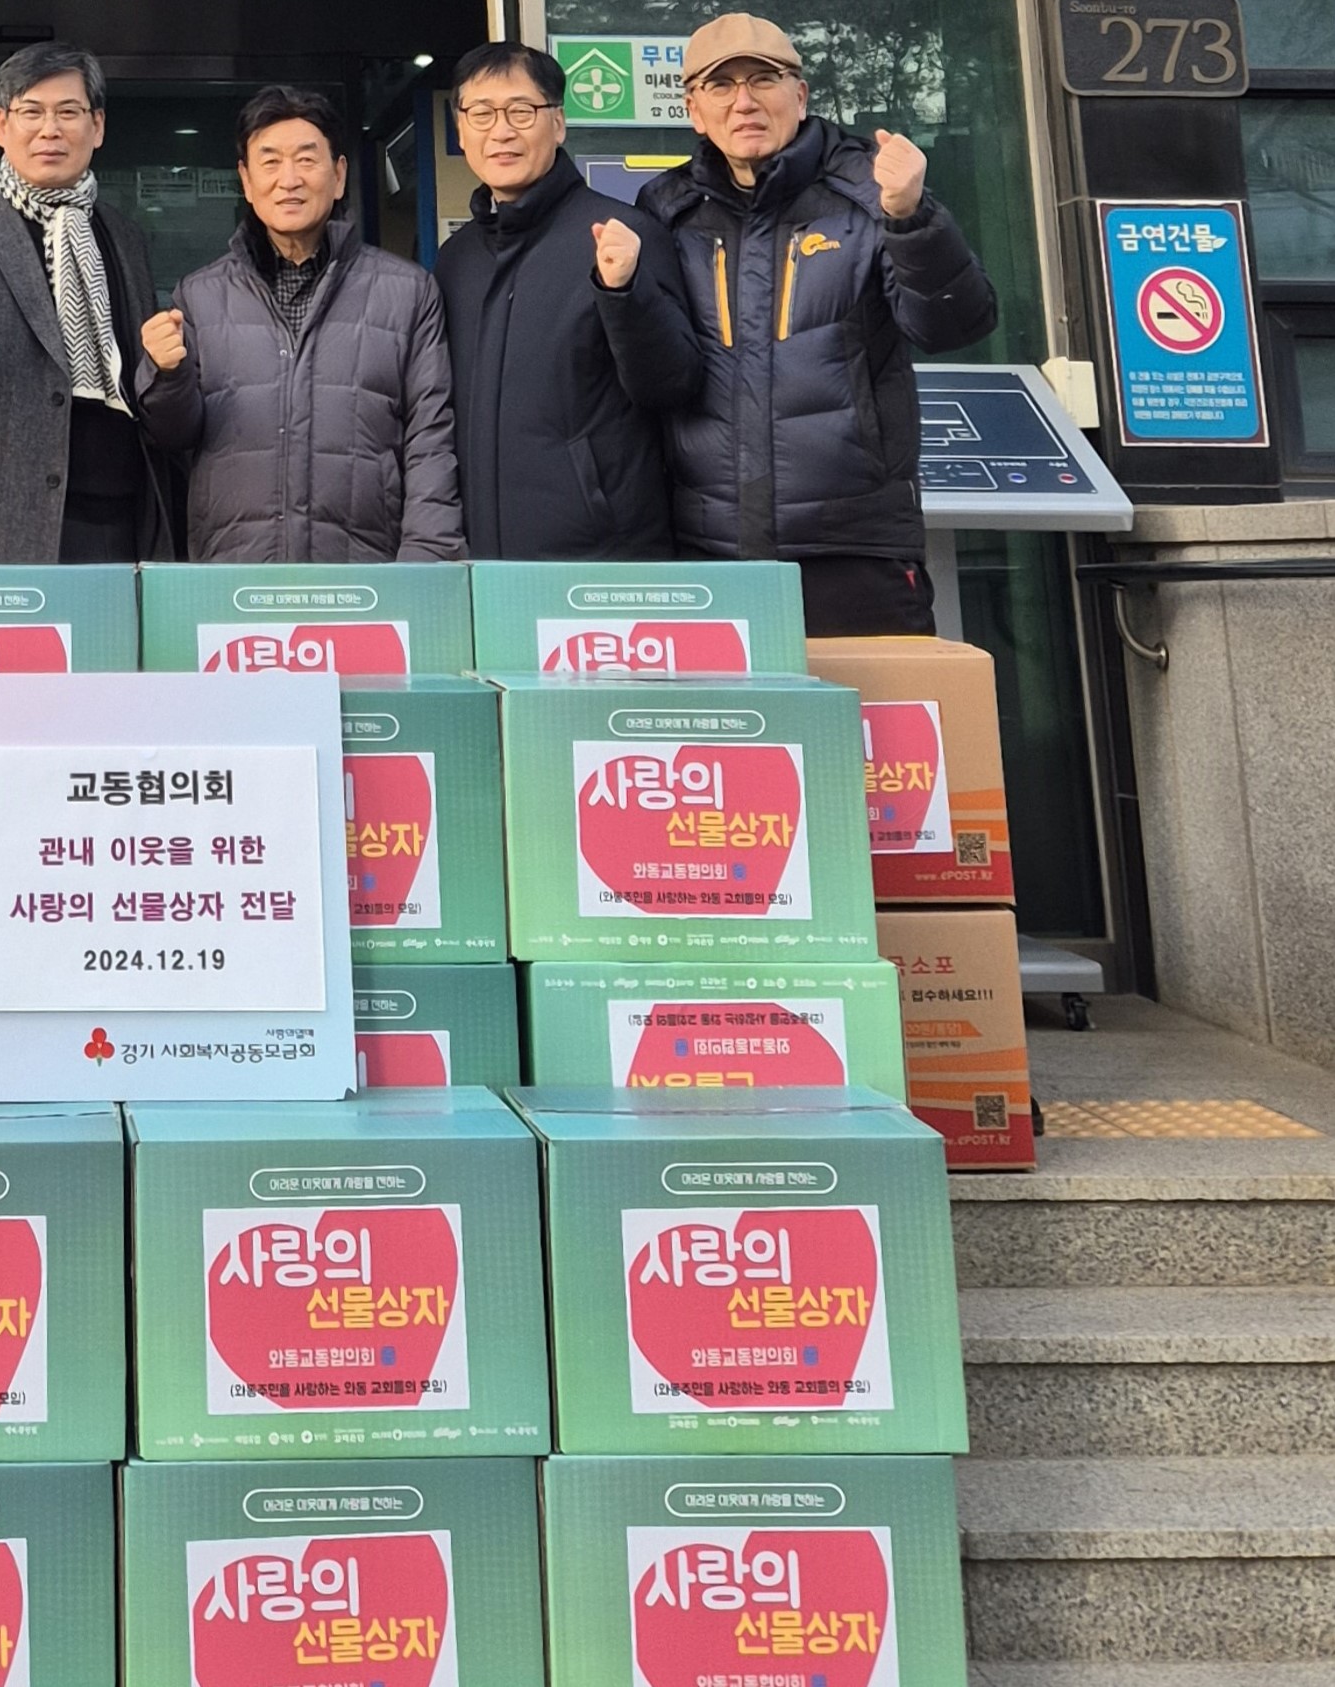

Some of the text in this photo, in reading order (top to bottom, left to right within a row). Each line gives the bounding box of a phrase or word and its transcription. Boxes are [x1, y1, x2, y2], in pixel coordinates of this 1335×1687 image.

[1100, 16, 1237, 84] 273
[1116, 224, 1217, 253] 금연건물
[67, 769, 234, 806] 교동협의회
[588, 760, 723, 811] 사랑의
[39, 836, 266, 867] 관내 이웃을 위한
[666, 812, 793, 848] 선물상자
[10, 892, 296, 923] 사랑의 선물상자 전달
[83, 949, 226, 972] 2024.12.19
[121, 1043, 315, 1064] 경기 사회복지공동모금회
[220, 1228, 372, 1287] 사랑의
[640, 1228, 792, 1287] 사랑의
[306, 1285, 449, 1329] 선물상자
[728, 1286, 870, 1328] 선물상자
[203, 1557, 359, 1622] 사랑의
[645, 1549, 801, 1610] 사랑의
[293, 1616, 441, 1665] 선물상자
[734, 1611, 881, 1655] 선물상자
